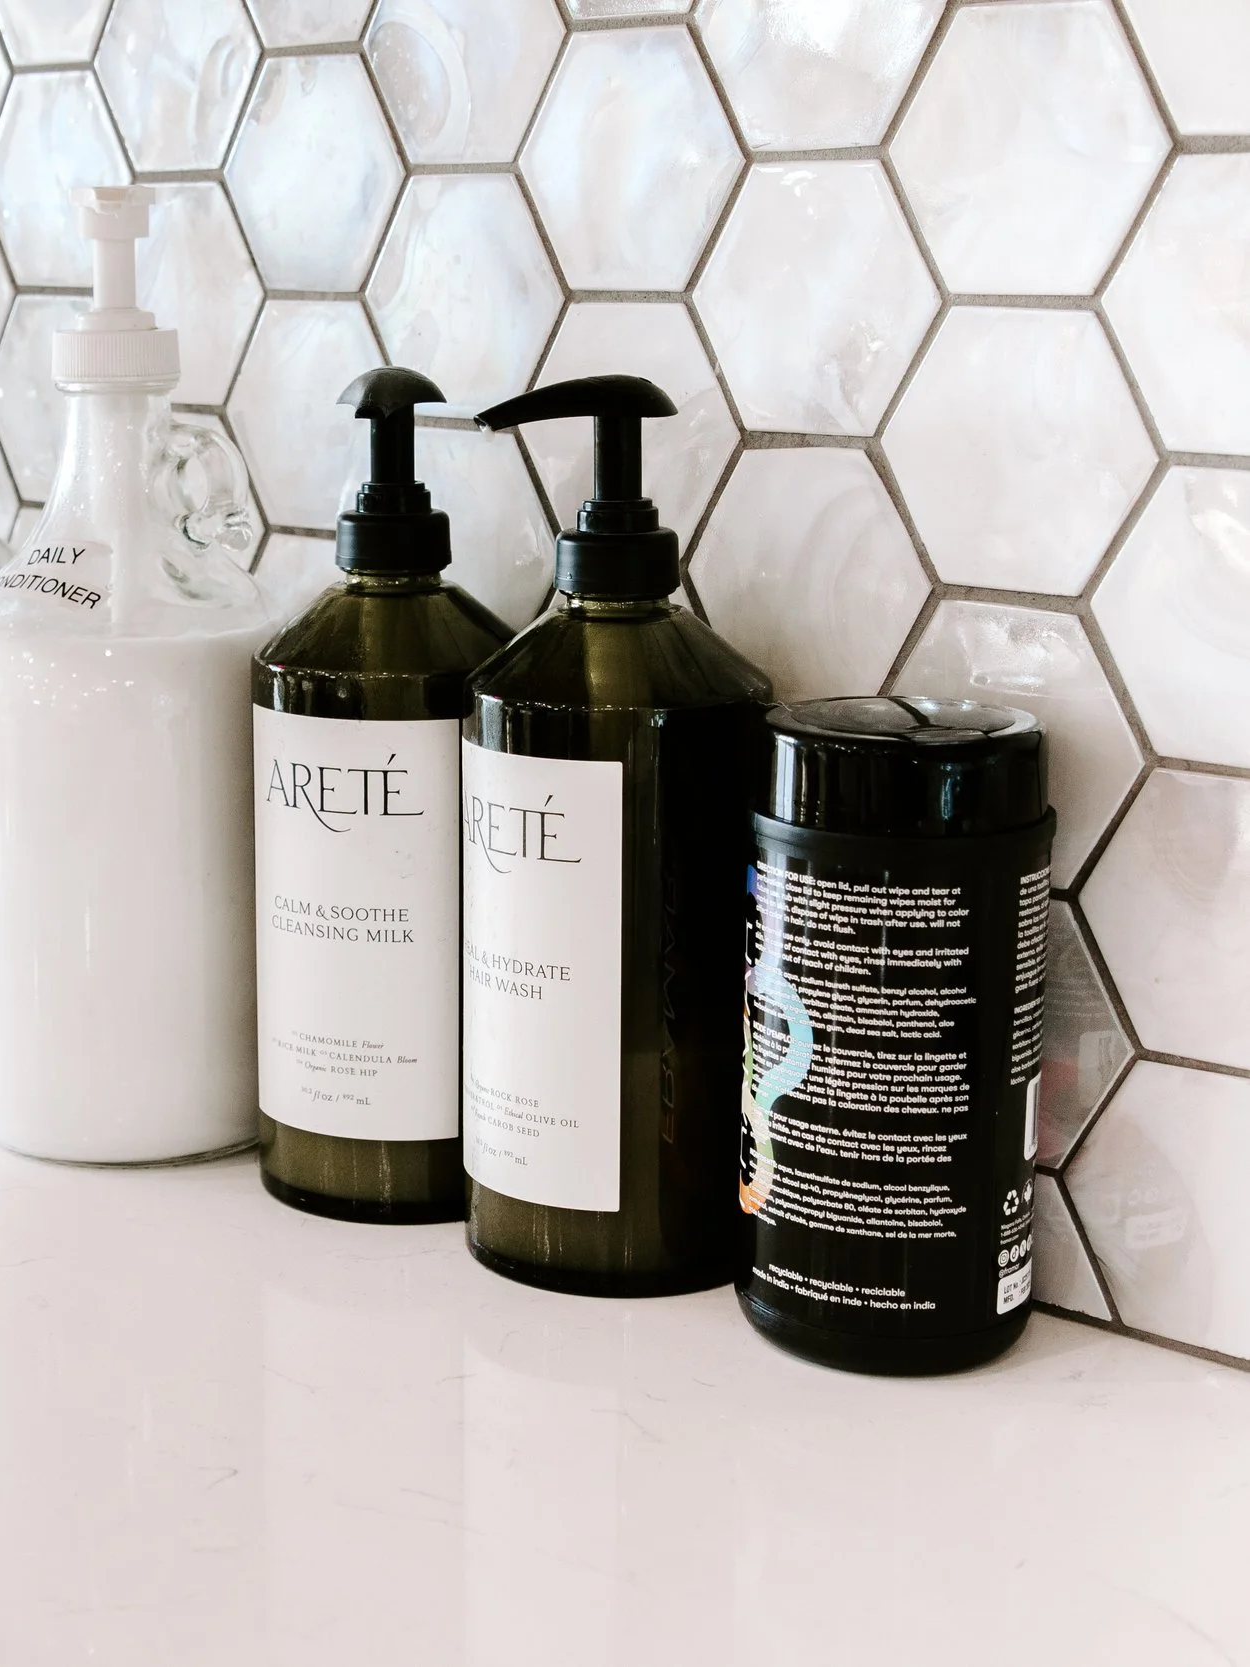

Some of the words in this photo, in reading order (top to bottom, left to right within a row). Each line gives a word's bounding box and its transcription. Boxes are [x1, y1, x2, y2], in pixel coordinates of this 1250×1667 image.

[27, 547, 86, 565] DAILY
[266, 753, 425, 833] ARETÉ
[784, 870, 799, 881] FOR
[798, 874, 816, 885] USE:
[816, 879, 836, 888] open
[838, 881, 851, 891] lid,
[852, 884, 869, 892] pull
[870, 886, 886, 894] out
[887, 886, 910, 896] wipe
[911, 886, 930, 895] and
[931, 887, 950, 895] tear
[951, 886, 960, 894] at
[784, 882, 802, 893] close
[802, 885, 812, 895] lid
[812, 888, 822, 897] to
[822, 889, 842, 901] keep
[843, 894, 887, 906] remaining
[888, 897, 915, 906] wipes
[916, 898, 941, 906] moist
[942, 897, 956, 905] for
[274, 895, 311, 916] CALM
[315, 904, 329, 921] &
[330, 905, 410, 922] SOOTHE
[792, 895, 808, 905] with
[808, 898, 830, 910] slight
[830, 903, 867, 914] pressure
[868, 906, 893, 916] when
[894, 908, 935, 919] applying
[936, 909, 946, 917] to
[947, 908, 969, 916] color
[271, 914, 359, 942] CLEANSING
[366, 929, 414, 943] MILK
[806, 918, 817, 928] do
[817, 922, 831, 931] not
[832, 923, 856, 934] flush.
[828, 913, 849, 923] wipe
[849, 915, 858, 924] in
[859, 917, 883, 926] trash
[884, 918, 907, 927] after
[929, 919, 944, 927] will
[945, 919, 960, 927] not
[812, 939, 835, 949] avoid
[835, 943, 869, 953] contact
[870, 946, 890, 955] with
[892, 949, 913, 957] eyes
[914, 948, 933, 956] and
[934, 947, 969, 956] irritated
[465, 940, 480, 962] EAL
[481, 950, 490, 969] &
[492, 953, 571, 981] HYDRATE
[781, 952, 792, 962] out
[792, 955, 801, 964] of
[800, 958, 823, 968] reach
[823, 961, 833, 970] of
[833, 963, 871, 975] children.
[819, 950, 838, 960] with
[838, 954, 862, 964] eyes,
[863, 956, 886, 966] rinse
[886, 958, 942, 968] immediately
[942, 958, 962, 966] with
[469, 964, 492, 988] HAIR
[495, 976, 542, 1000] WASH
[880, 986, 906, 996] benzyl
[907, 987, 938, 995] alcohol,
[939, 986, 966, 995] alcohol
[299, 1032, 358, 1048] CHAMOMILE
[361, 1040, 385, 1049] Flower
[845, 1026, 865, 1035] dead
[881, 1029, 899, 1038] salt,
[900, 1030, 922, 1038] lactic
[922, 1030, 942, 1038] acid.
[295, 1046, 317, 1057] MILK
[329, 1051, 393, 1064] CALENDULA
[396, 1055, 418, 1064] Bloom
[831, 1046, 875, 1059] couvercle,
[876, 1050, 896, 1060] tirez
[913, 1052, 922, 1061] la
[924, 1052, 957, 1062] lingette
[958, 1051, 966, 1059] et
[330, 1065, 356, 1076] ROSE
[359, 1068, 378, 1078] HIP
[356, 1097, 372, 1106] mL
[490, 1088, 512, 1102] ROCK
[515, 1096, 539, 1108] ROSE
[882, 1104, 899, 1113] des
[900, 1105, 939, 1114] cheveux.
[953, 1105, 968, 1114] pas
[487, 1116, 514, 1132] CAROB
[516, 1126, 540, 1138] SEED
[525, 1113, 556, 1126] OLIVE
[560, 1119, 580, 1128] OIL
[876, 1133, 911, 1142] contact
[934, 1133, 946, 1141] les
[947, 1133, 967, 1142] yeux
[514, 1157, 528, 1166] mL
[860, 1151, 880, 1161] hors
[881, 1153, 894, 1162] de
[895, 1154, 904, 1162] la
[906, 1154, 935, 1164] portée
[936, 1154, 951, 1162] des
[752, 1266, 766, 1280] made
[766, 1272, 772, 1283] in
[772, 1276, 789, 1290] india
[794, 1284, 828, 1300] fabriqué
[829, 1295, 840, 1303] en
[842, 1295, 862, 1306] inde
[869, 1299, 898, 1309] hecho
[913, 1301, 935, 1309] india
[768, 1263, 803, 1282] recyclable
[808, 1278, 853, 1292] recyclable
[860, 1287, 905, 1296] reciclable
